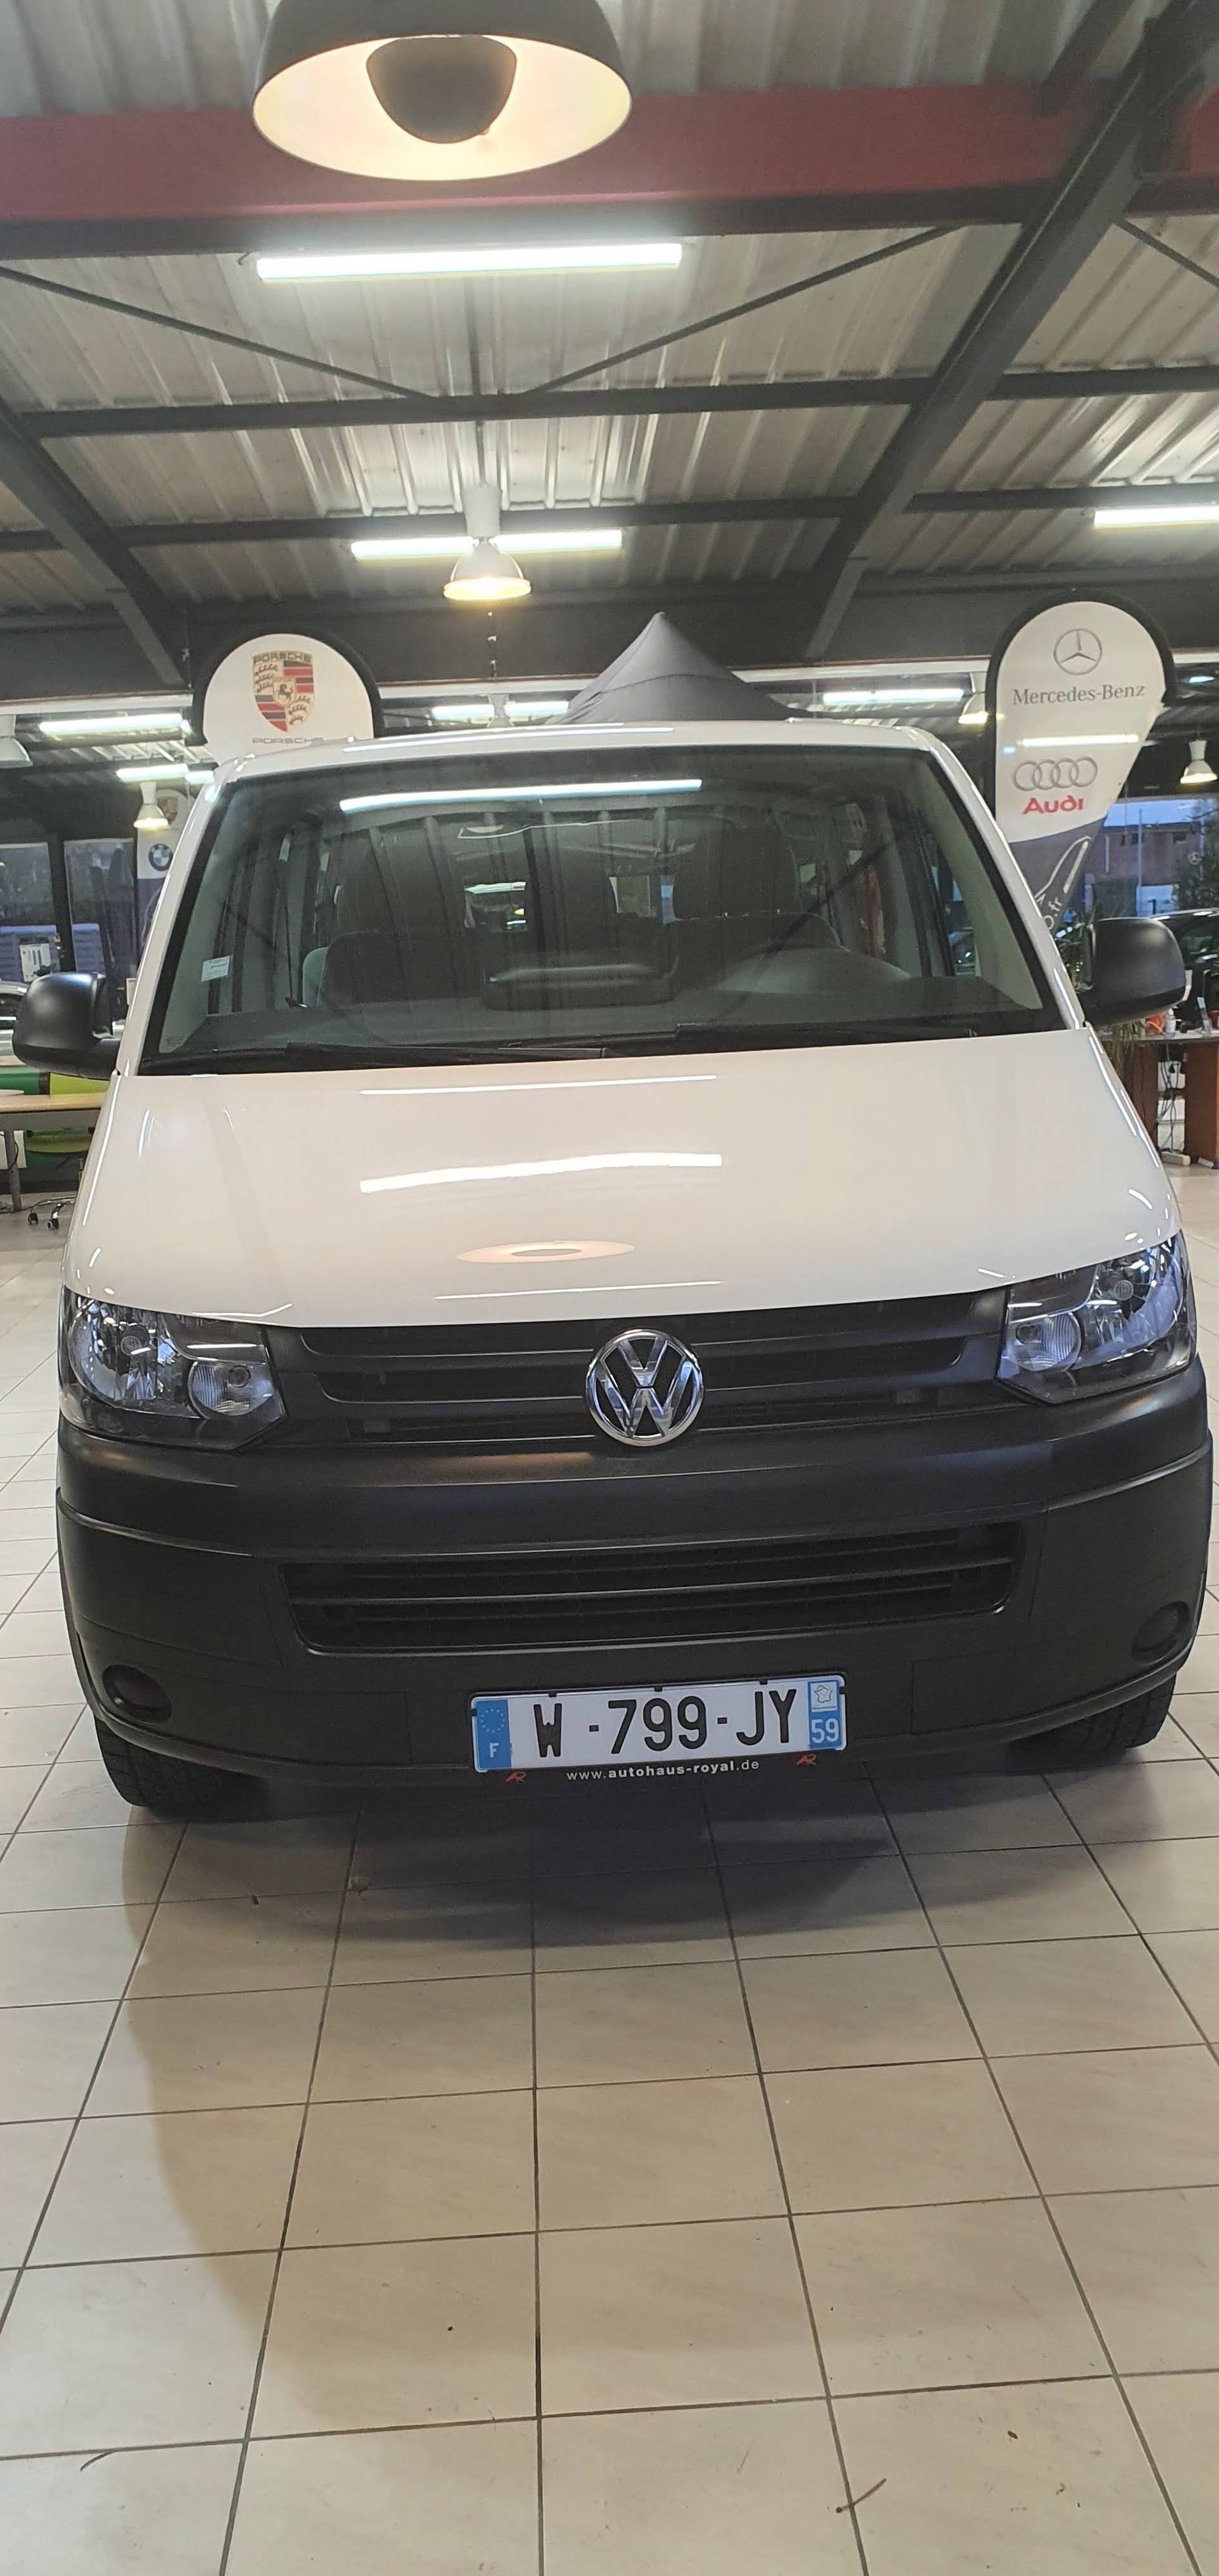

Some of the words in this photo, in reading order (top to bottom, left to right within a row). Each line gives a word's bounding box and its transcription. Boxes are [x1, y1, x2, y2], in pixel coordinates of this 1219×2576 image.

[254, 652, 312, 664] PORSCHE
[1013, 684, 1146, 705] Mercedes-Benz
[1023, 795, 1084, 815] Audi
[811, 1717, 839, 1744] 59
[489, 1742, 500, 1758] F
[567, 1759, 759, 1781] www.autohaus-royal.de
